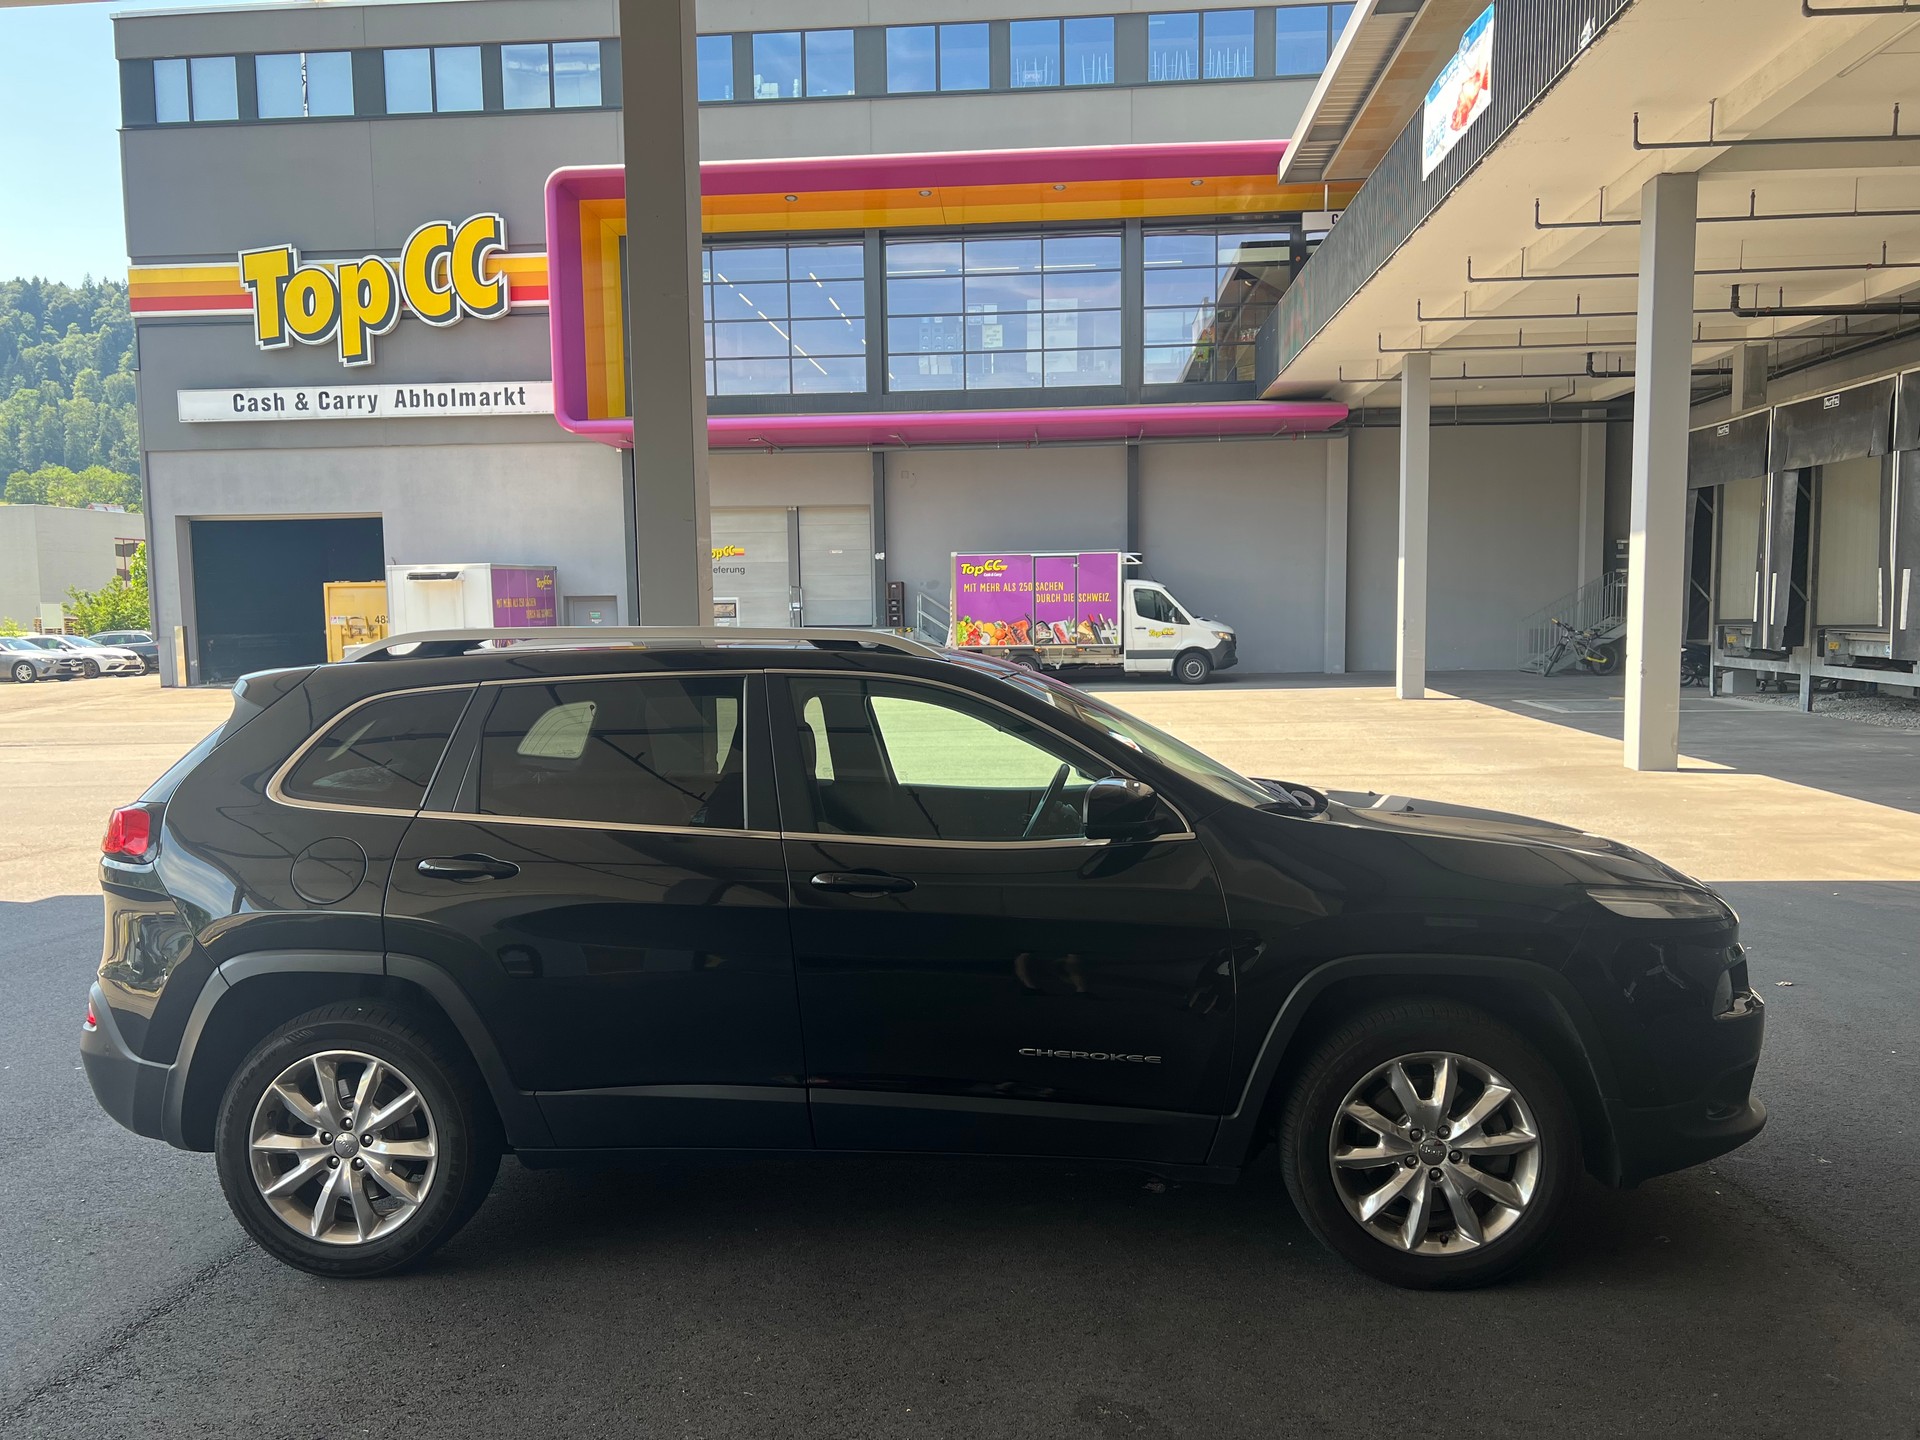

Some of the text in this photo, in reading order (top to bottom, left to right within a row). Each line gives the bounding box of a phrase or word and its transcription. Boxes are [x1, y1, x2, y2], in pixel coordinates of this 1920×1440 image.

[232, 386, 526, 413] Cash & Carry Abholmarkt
[963, 582, 1064, 592] MIT MEHR ALS 250 SACHEN
[1036, 592, 1112, 603] DURCH DIE SCHWEIZ.
[1018, 1048, 1162, 1064] CHEROKEE
